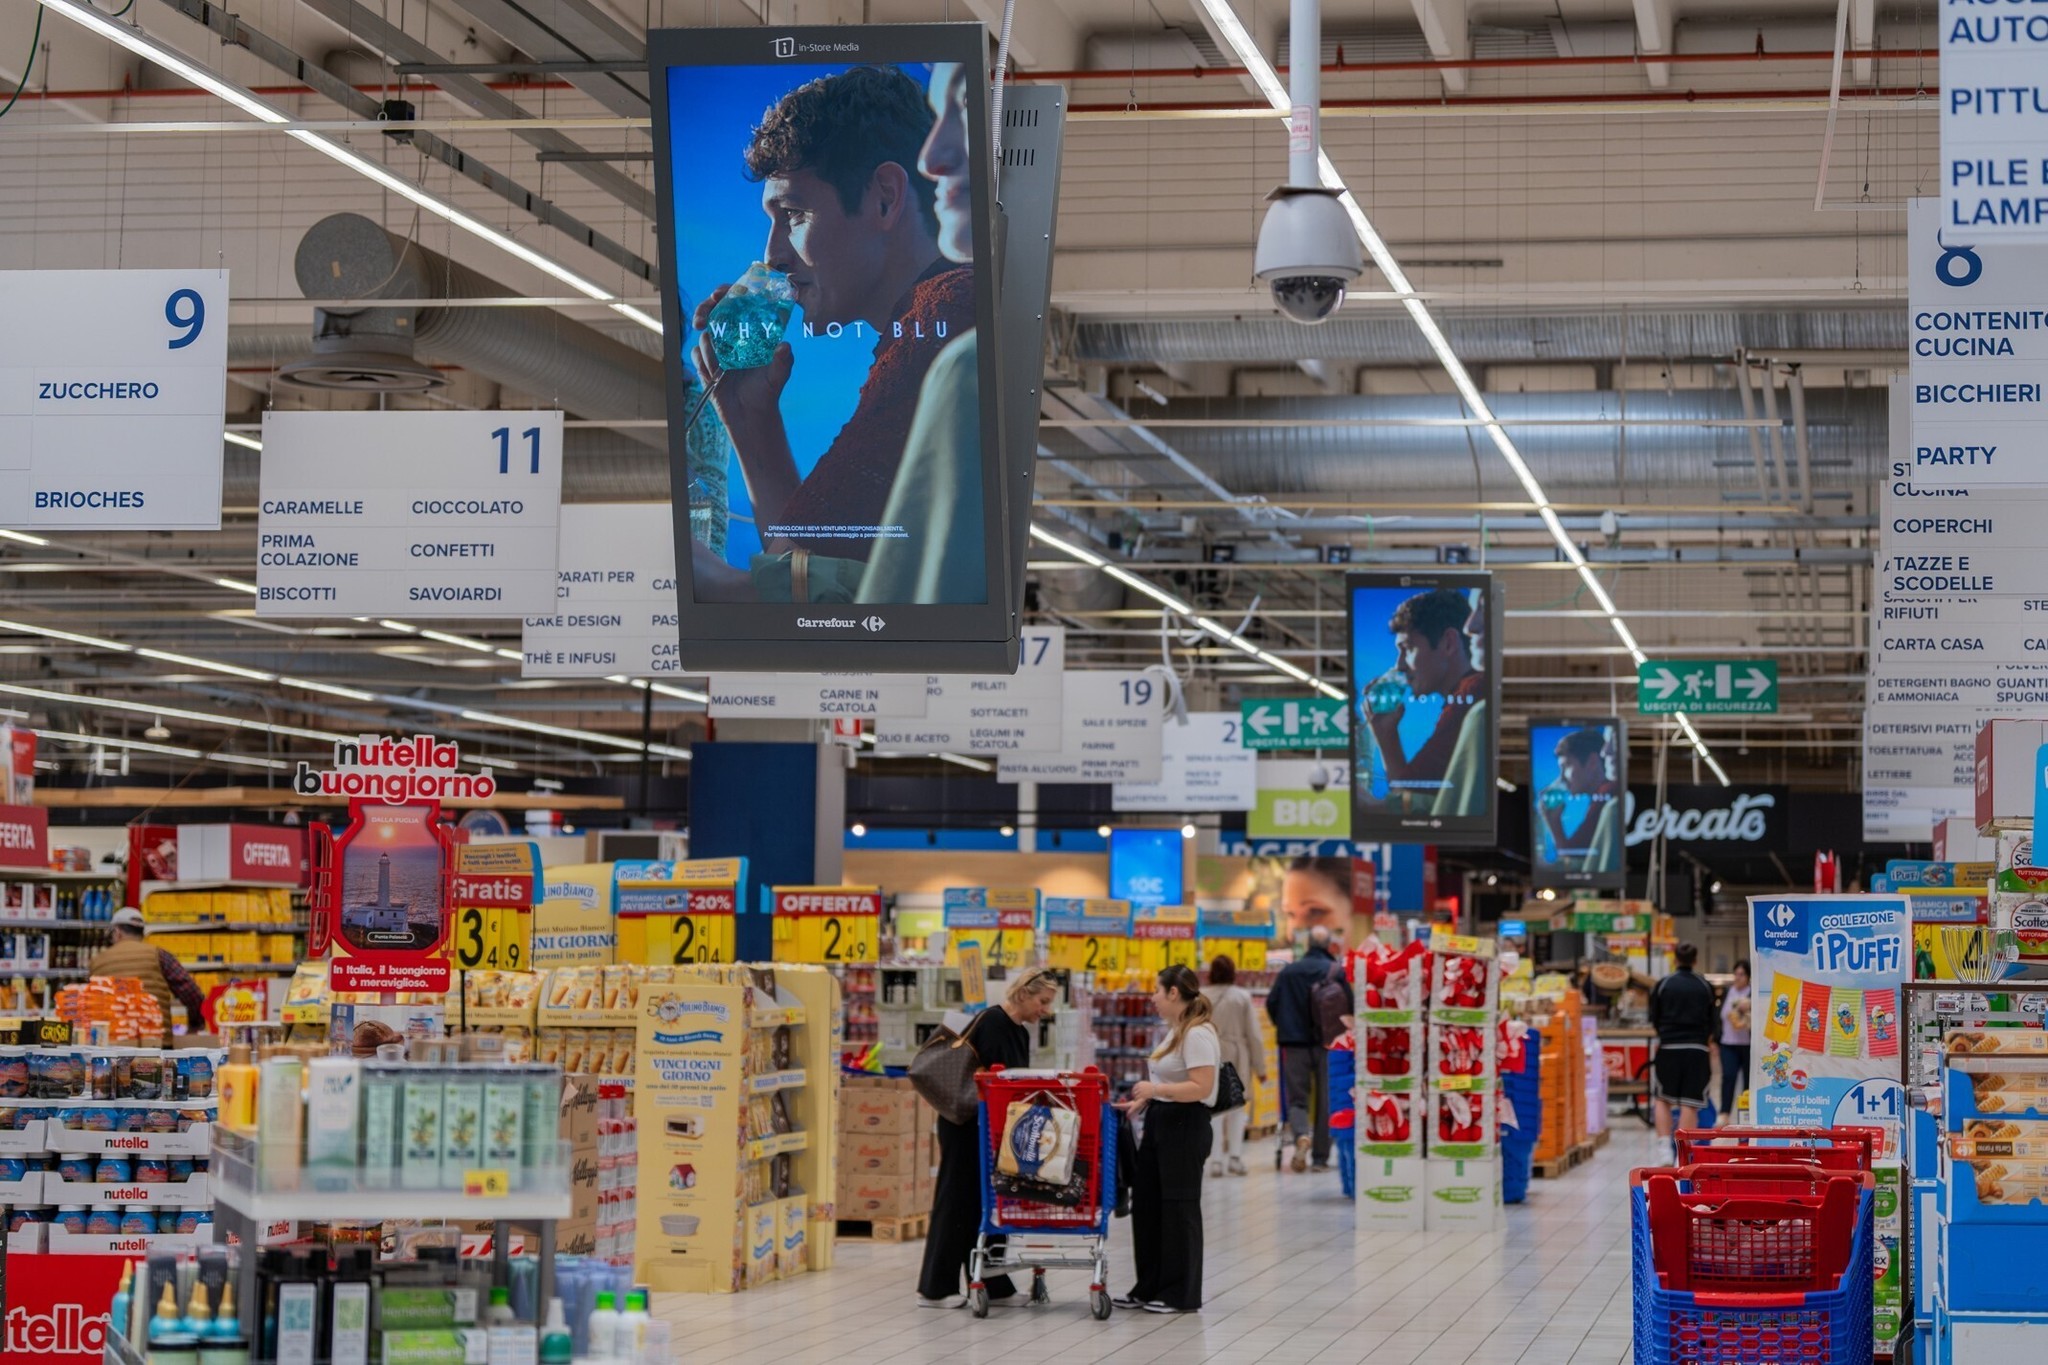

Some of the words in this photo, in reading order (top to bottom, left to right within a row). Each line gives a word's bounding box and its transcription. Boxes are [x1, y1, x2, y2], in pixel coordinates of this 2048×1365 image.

[1949, 16, 2048, 43] AUTO
[833, 42, 860, 52] Media
[1952, 159, 2028, 187] PILE
[1935, 226, 1983, 287] 8
[164, 287, 206, 350] 9
[1915, 311, 2048, 331] CONTENIT
[709, 321, 777, 339] WHY
[802, 321, 864, 338] NOT
[893, 320, 948, 338] BLU
[1915, 337, 2014, 357] CUCINA
[39, 382, 159, 401] ZUCCHERO
[1915, 383, 2041, 404] BICCHIERI
[490, 427, 541, 475] 11
[1916, 446, 1997, 466] PARTY
[35, 490, 145, 509] BRIOCHES
[262, 500, 364, 515] CARAMELLE
[411, 500, 524, 516] CIOCCOLATO
[1893, 518, 1992, 534] COPERCHI
[261, 533, 315, 548] PRIMA
[410, 543, 495, 558] CONFETTI
[260, 552, 359, 567] COLAZIONE
[1893, 557, 1953, 571] TAZZE
[1959, 557, 1970, 571] E
[607, 571, 635, 583] PER
[1893, 576, 1994, 591] SCODELLE
[259, 586, 337, 601] BISCOTTI
[408, 586, 502, 601] SAVOIARDI
[1883, 607, 1939, 619] RIFIUTI
[567, 615, 621, 627] DESIGN
[651, 615, 679, 626] PAS
[796, 616, 856, 628] Carrefour
[1020, 637, 1051, 666] 17
[1883, 638, 1937, 651] CARTA
[1940, 638, 1985, 651] CASA
[2023, 638, 2048, 651] CA
[524, 649, 552, 664] THÈ
[556, 653, 565, 664] E
[568, 653, 616, 664] INFUSI
[970, 681, 1008, 691] PELATI
[1878, 678, 1948, 688] DETERGENTI
[1950, 678, 1992, 688] BAGNO
[819, 689, 863, 700] CARNE
[866, 689, 879, 700] IN
[1118, 679, 1152, 706] 19
[1878, 692, 1885, 701] E
[1887, 692, 1960, 702] AMMONIACA
[711, 695, 776, 707] MAIONESE
[819, 702, 877, 713] SCATOLA
[1644, 702, 1688, 712] USCITA
[1691, 702, 1705, 712] DI
[1708, 702, 1773, 712] SICUREZZA
[970, 708, 1029, 718] SOTTACETI
[1082, 719, 1106, 727] SALE
[1117, 719, 1148, 728] SPEZIE
[1872, 724, 1933, 734] DETERSIVI
[1935, 724, 1972, 734] PIATTI
[877, 734, 898, 743] OLIO
[900, 734, 911, 743] E
[914, 733, 950, 743] ACETO
[969, 728, 1009, 738] LEGUMI
[1013, 728, 1025, 738] IN
[1222, 721, 1238, 743] 2
[969, 739, 1019, 749] SCATOLA
[1081, 742, 1116, 751] FARINE
[1246, 737, 1287, 747] USCITA
[1289, 737, 1302, 747] DI
[338, 737, 458, 769] nutella
[1868, 746, 1944, 756] TOELETTATURA
[999, 765, 1028, 774] PASTA
[1081, 760, 1107, 769] PRIMI
[1109, 760, 1140, 768] PIATTI
[1092, 770, 1126, 778] BUSTA
[1867, 770, 1913, 780] LETTIERE
[298, 763, 495, 803] buongiorno
[1272, 798, 1339, 827] BIO
[1624, 790, 1776, 847] ercato
[371, 816, 397, 824] DALLA
[243, 841, 292, 867] OFFERTA
[452, 876, 524, 900] Gratis
[689, 895, 732, 911] -20%
[781, 894, 875, 913] OFFERTA
[1821, 912, 1894, 928] COLLEZIONE
[1912, 908, 1949, 918] YBACK
[458, 908, 484, 967] 3
[673, 915, 695, 964] 2
[823, 917, 842, 960] 2
[1764, 929, 1799, 939] Carrefour
[987, 930, 1004, 965] 4
[1774, 939, 1788, 948] iper
[1086, 937, 1099, 971] 2
[333, 964, 343, 975] In
[346, 964, 376, 976] Italia,
[379, 964, 386, 975] il
[388, 964, 447, 977] buongiorno
[360, 977, 429, 989] meraviglioso.
[653, 1059, 687, 1070] VINCI
[689, 1060, 721, 1071] OGNI
[662, 1071, 711, 1081] GIORNO
[1765, 1094, 1801, 1106] Raccogli
[1806, 1095, 1831, 1105] bollini
[1850, 1085, 1896, 1116] 1+1
[1774, 1107, 1781, 1115] e
[1782, 1106, 1822, 1116] colleziona
[1773, 1116, 1792, 1125] tutti
[1797, 1116, 1823, 1127] premi!
[105, 1137, 149, 1149] nutella
[104, 1187, 149, 1200] nutella
[267, 1219, 290, 1238] nutella
